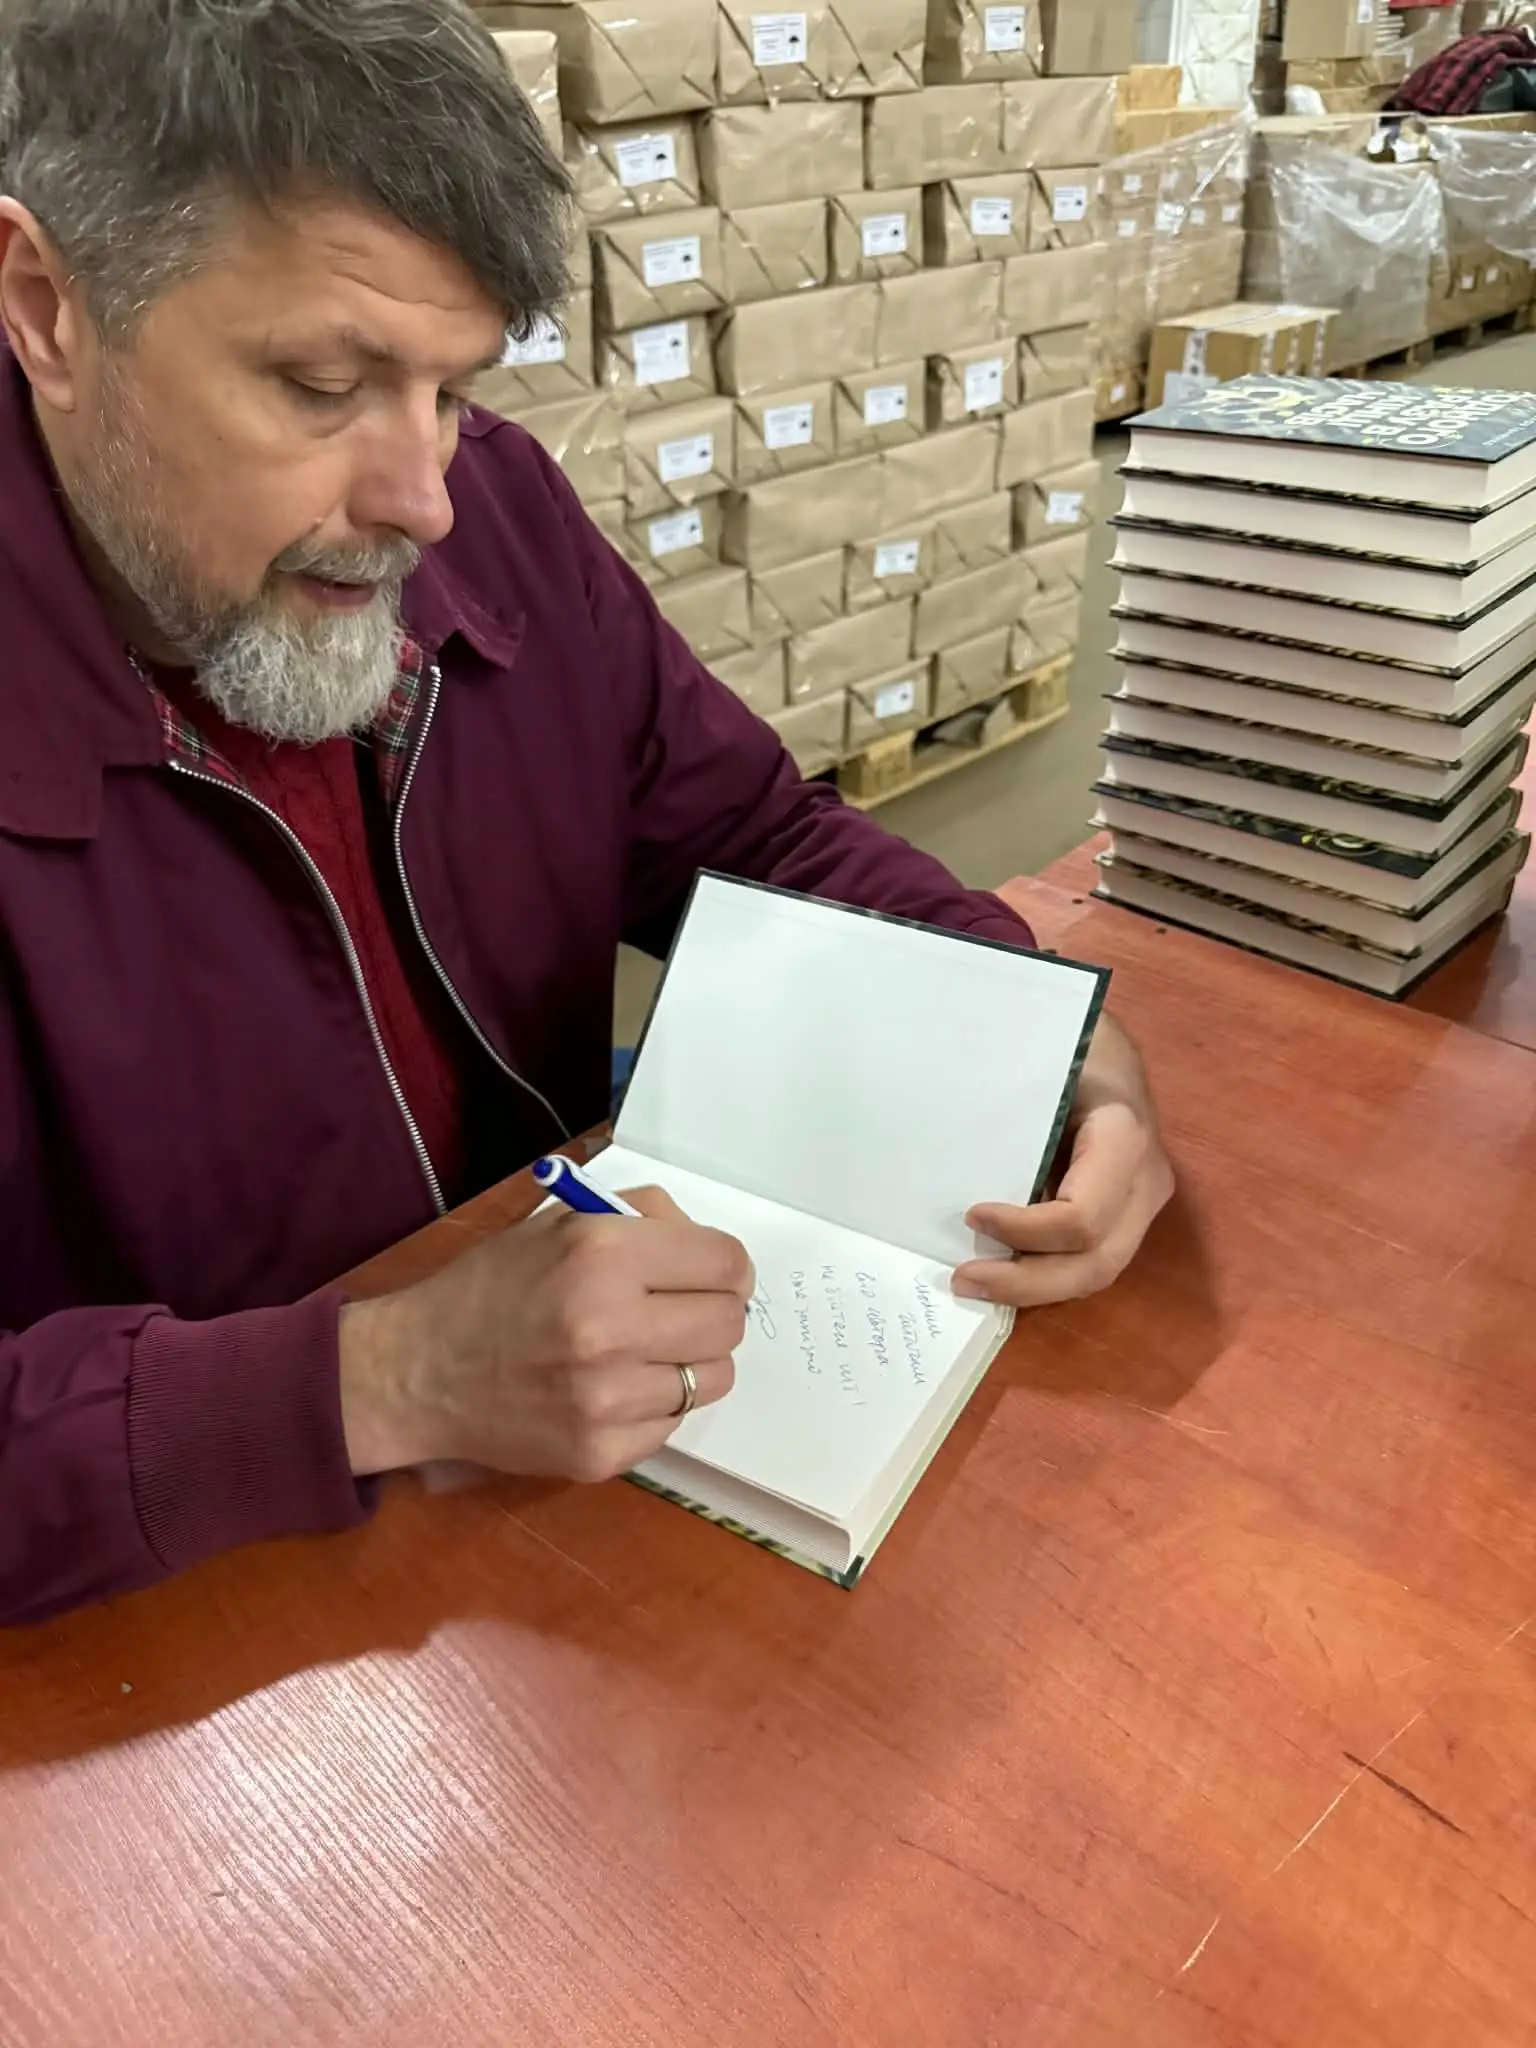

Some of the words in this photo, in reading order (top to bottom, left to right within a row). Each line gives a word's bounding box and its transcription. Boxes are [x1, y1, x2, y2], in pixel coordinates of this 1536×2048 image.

[1284, 391, 1387, 425] ЧАСІВ
[1326, 395, 1422, 427] КІНЦІ
[1388, 394, 1472, 426] РАЗУ
[1397, 394, 1520, 444] ОДНОГО
[1360, 425, 1407, 435] В
